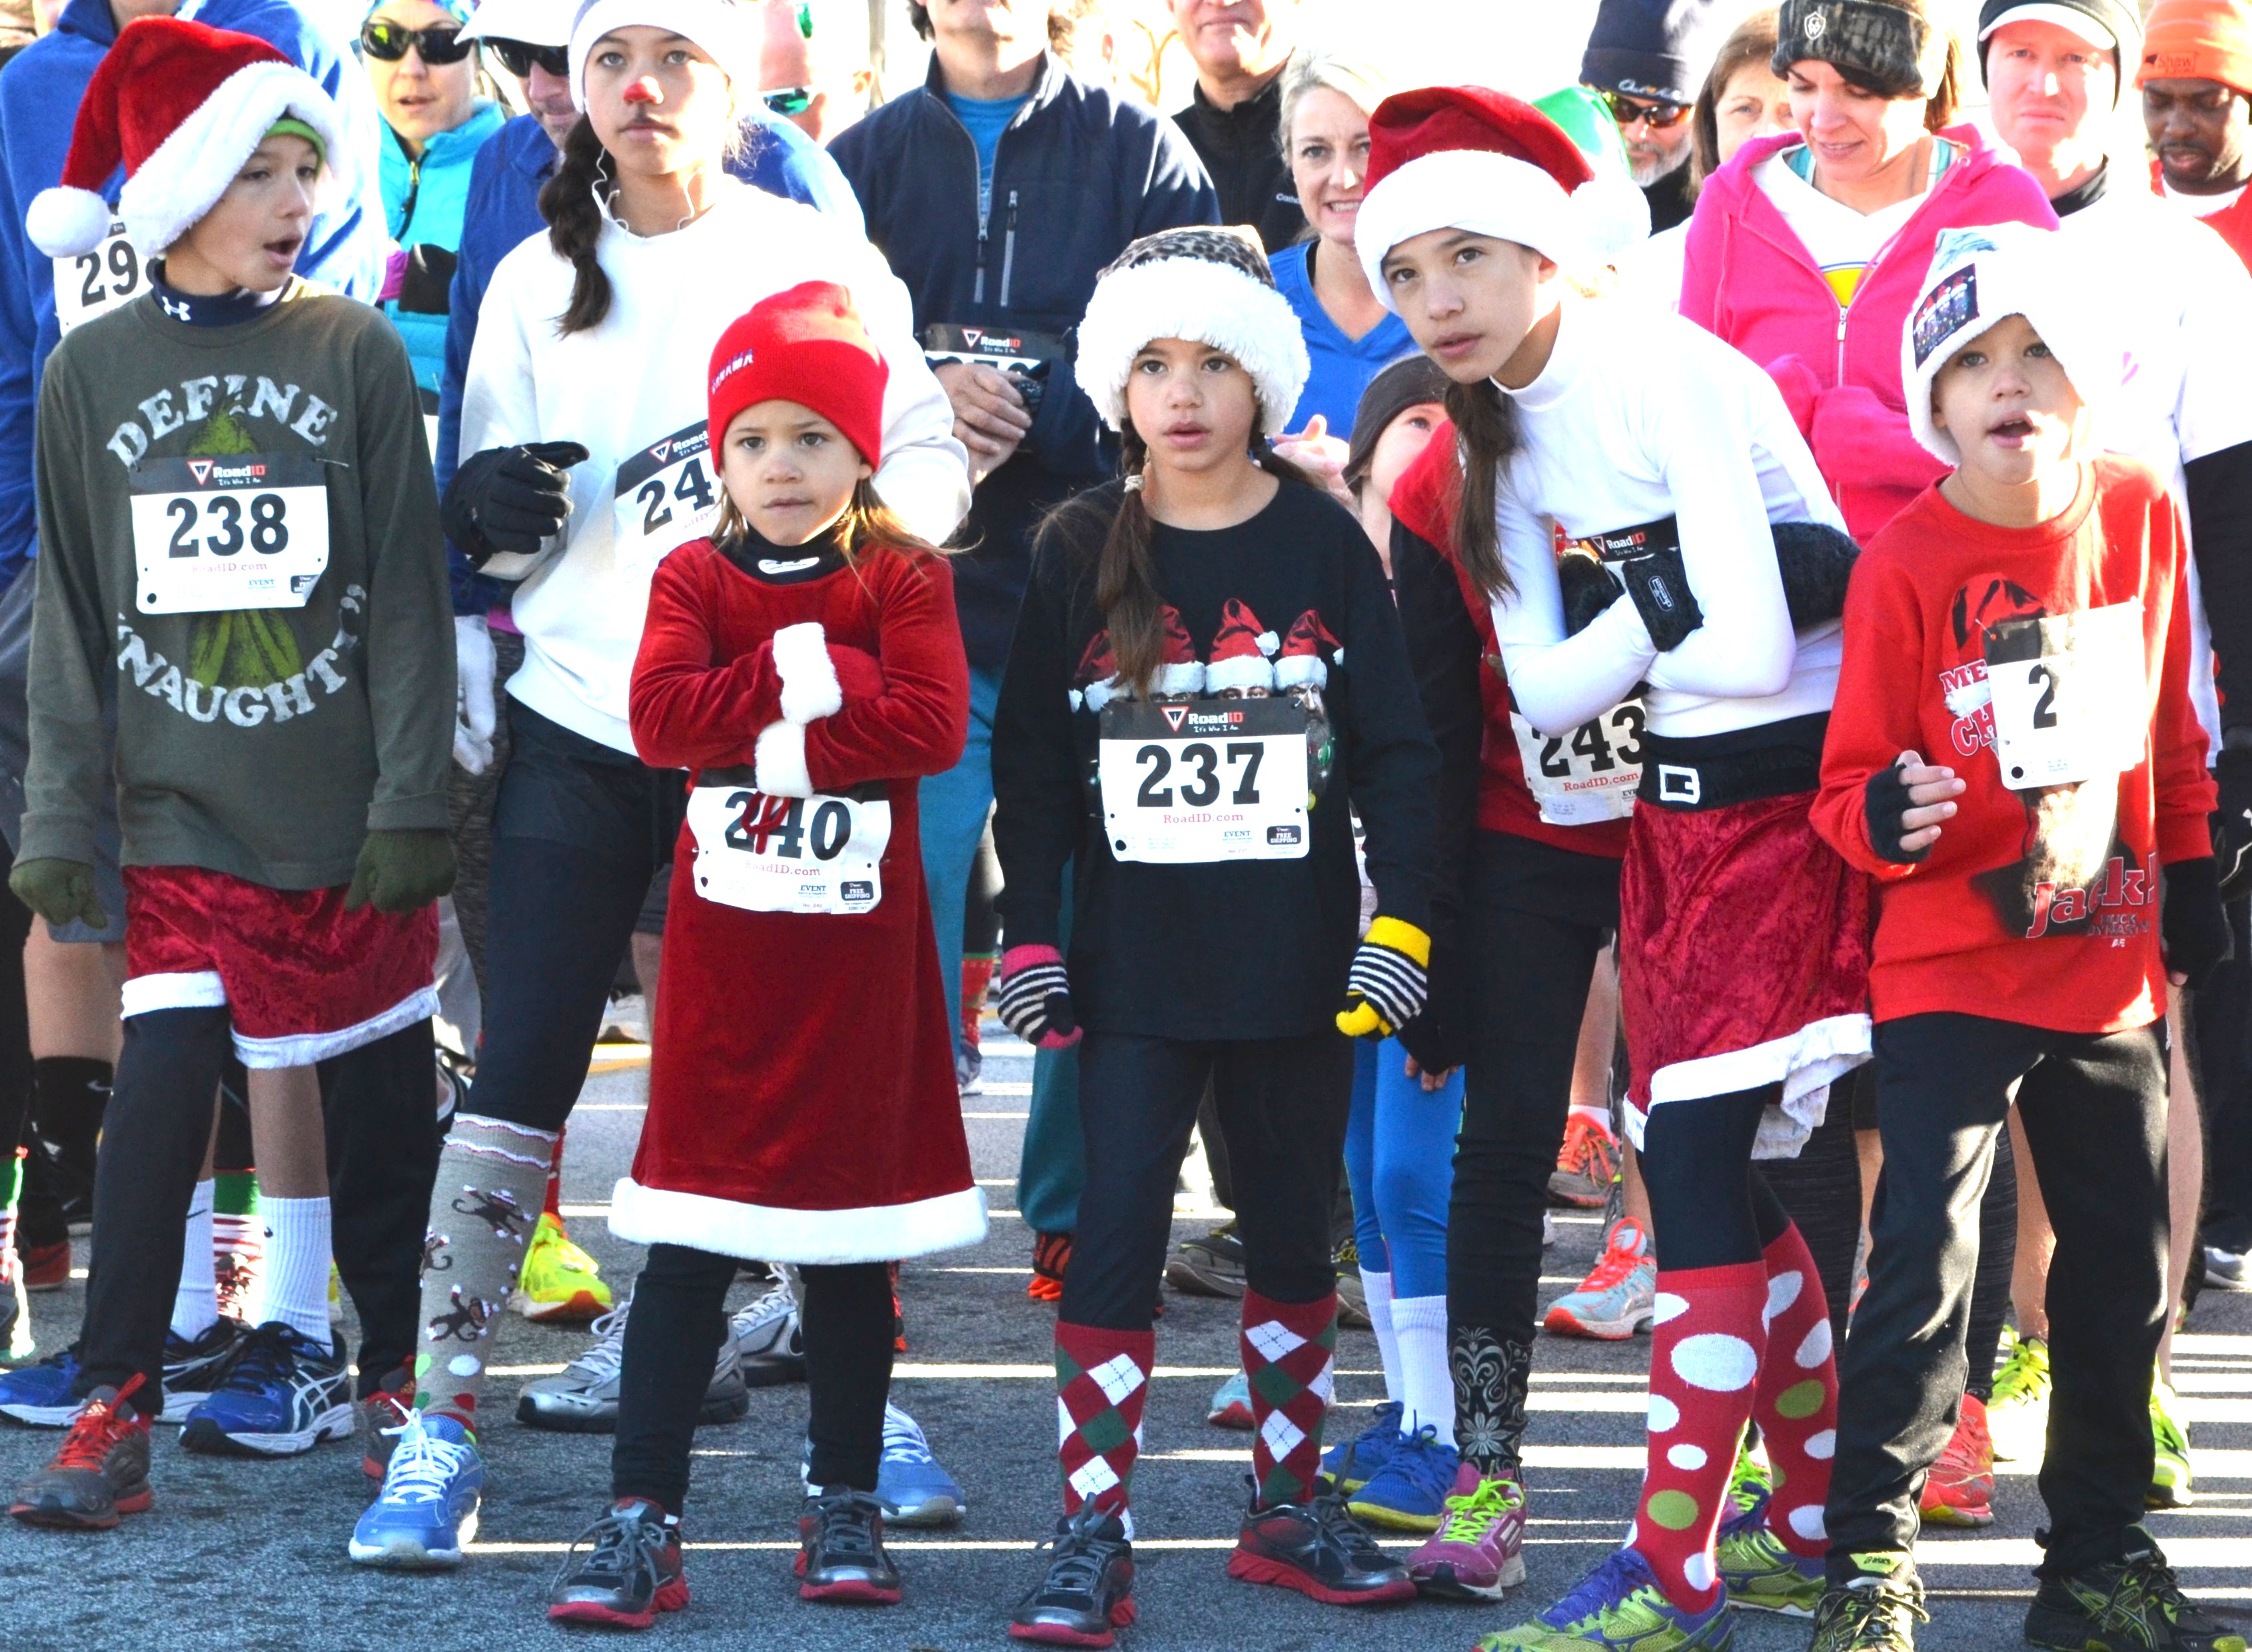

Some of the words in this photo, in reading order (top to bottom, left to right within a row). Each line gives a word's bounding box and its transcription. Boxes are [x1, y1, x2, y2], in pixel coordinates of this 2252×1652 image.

[76, 240, 155, 308] 29
[981, 336, 1022, 347] RoadID
[107, 374, 338, 469] DEFINE
[672, 430, 708, 453] Road
[213, 465, 266, 479] RoadID
[636, 458, 716, 536] 24
[167, 493, 289, 558] 238
[1606, 532, 1646, 550] RoadID
[192, 562, 268, 574] RoadID.com
[1939, 659, 1989, 694] ME
[2028, 663, 2057, 729] 2
[1188, 712, 1244, 725] RoadID
[1952, 700, 1997, 756] CH
[1531, 705, 1647, 778] 243
[1136, 741, 1265, 808] 237
[1563, 771, 1639, 791] RoadID.com
[724, 791, 851, 861] 240
[1163, 813, 1244, 824] RoadID.com
[746, 859, 821, 877] RoadID.com
